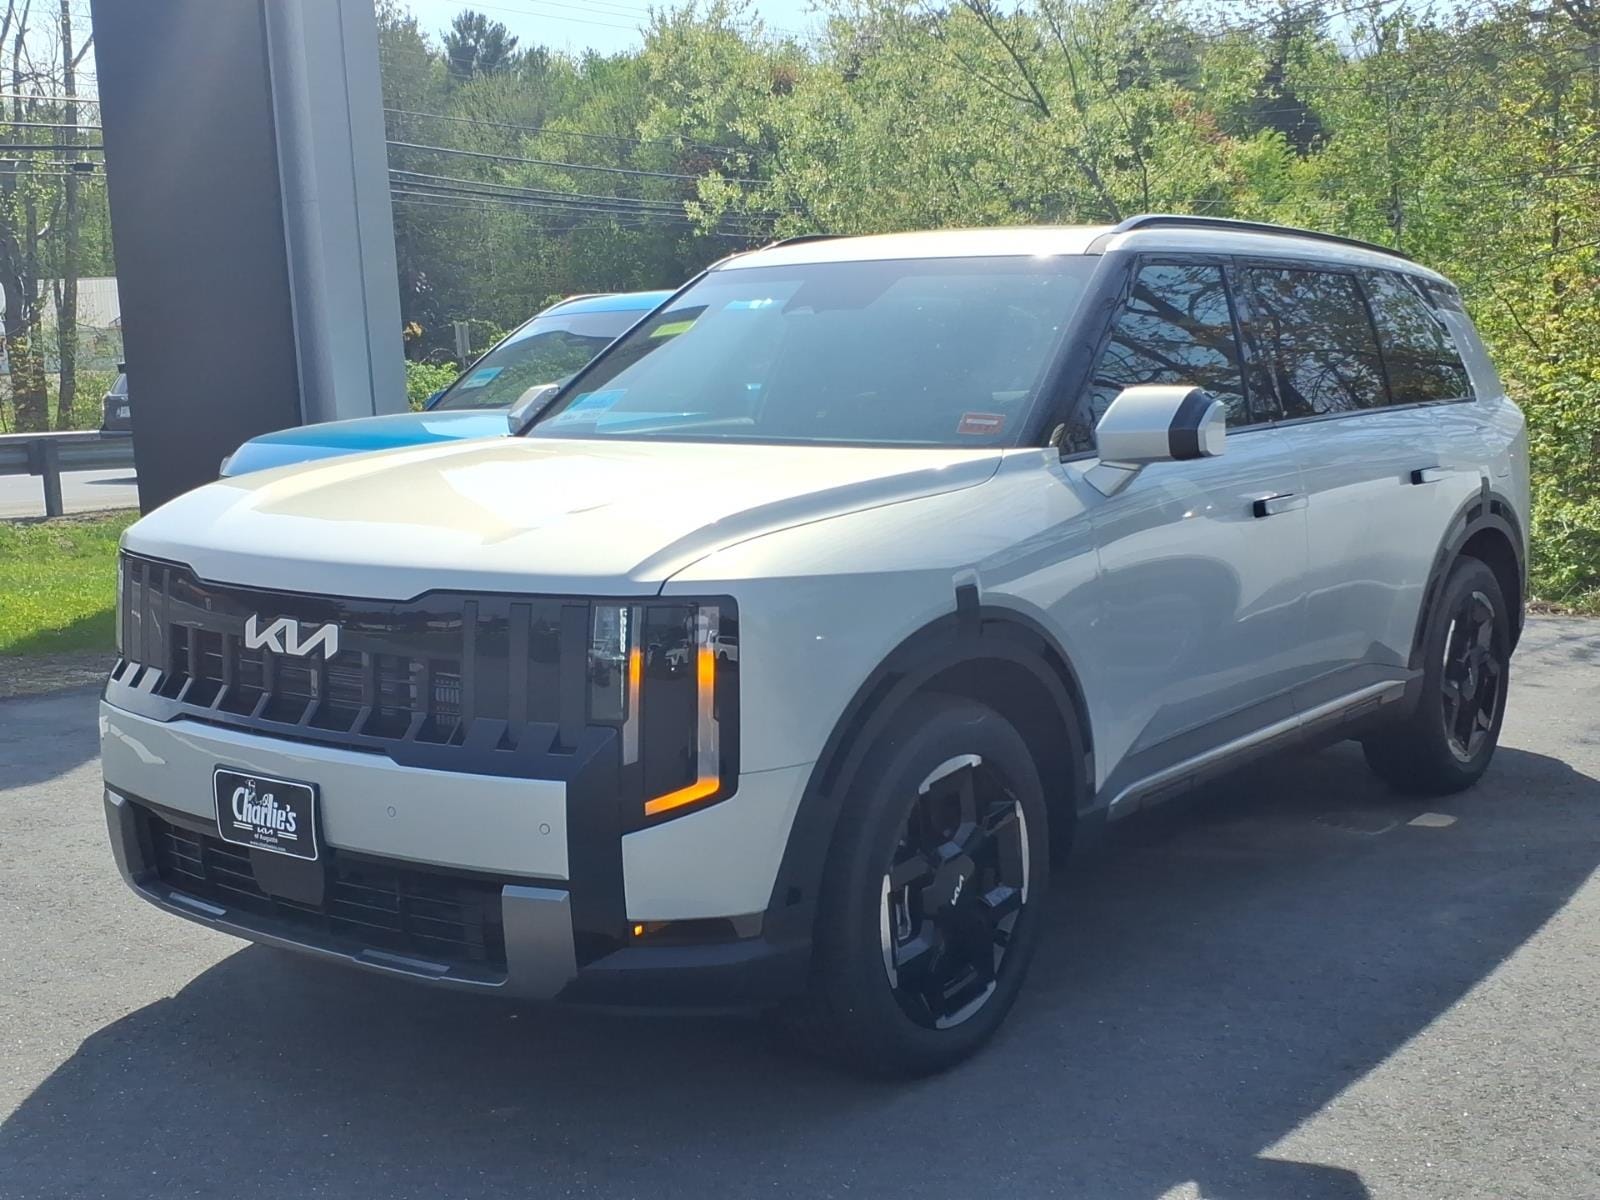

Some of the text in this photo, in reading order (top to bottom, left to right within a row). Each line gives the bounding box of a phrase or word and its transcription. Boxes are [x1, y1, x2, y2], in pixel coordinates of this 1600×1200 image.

[245, 614, 338, 660] KIA
[232, 786, 297, 832] Charlie's
[257, 826, 274, 836] KIA
